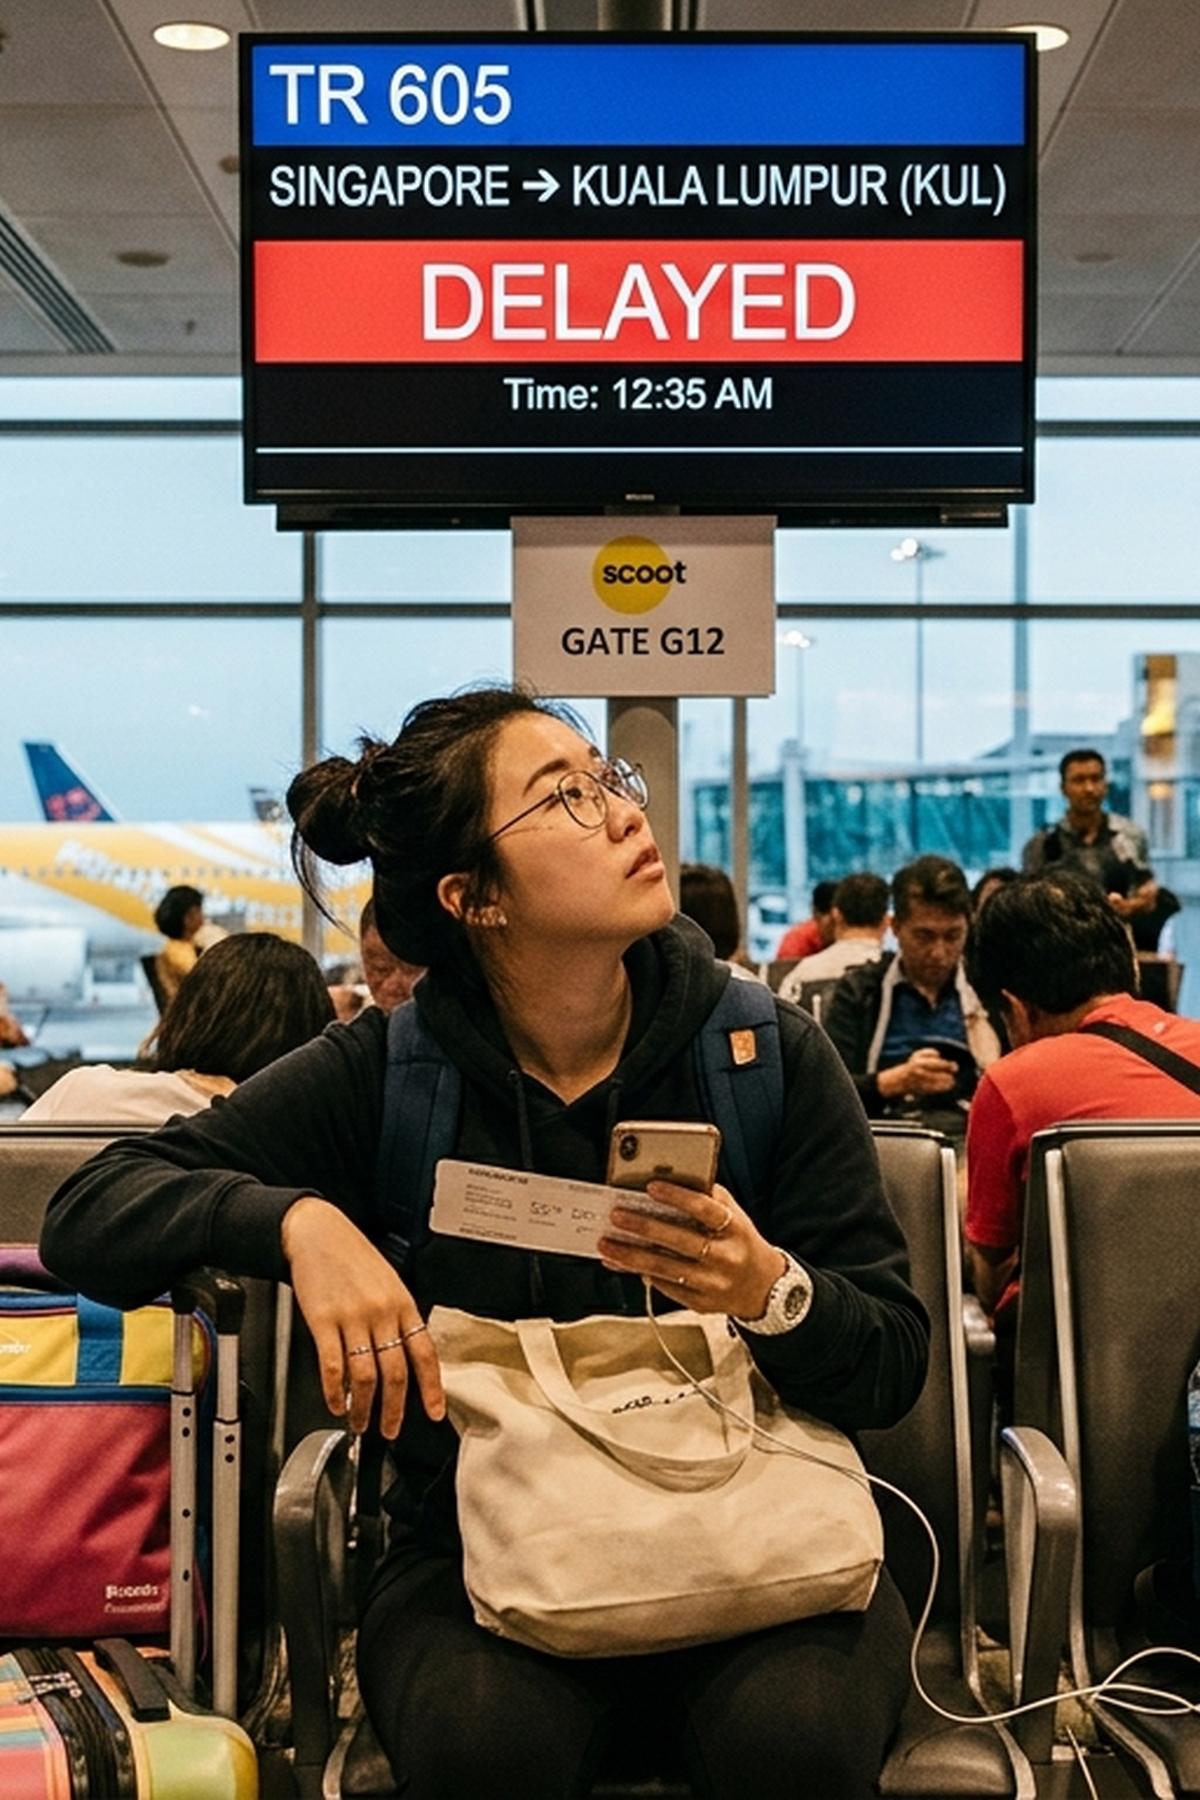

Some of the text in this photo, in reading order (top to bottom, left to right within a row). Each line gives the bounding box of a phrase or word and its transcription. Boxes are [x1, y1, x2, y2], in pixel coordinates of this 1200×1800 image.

[269, 64, 512, 126] TR 605
[269, 163, 1007, 217] SINGAPORE KUALA LUMPUR (KUL)
[422, 263, 857, 342] DELAYED
[503, 377, 774, 411] Time: 12:35 AM
[602, 560, 688, 586] scoot
[561, 626, 726, 657] GATE G12
